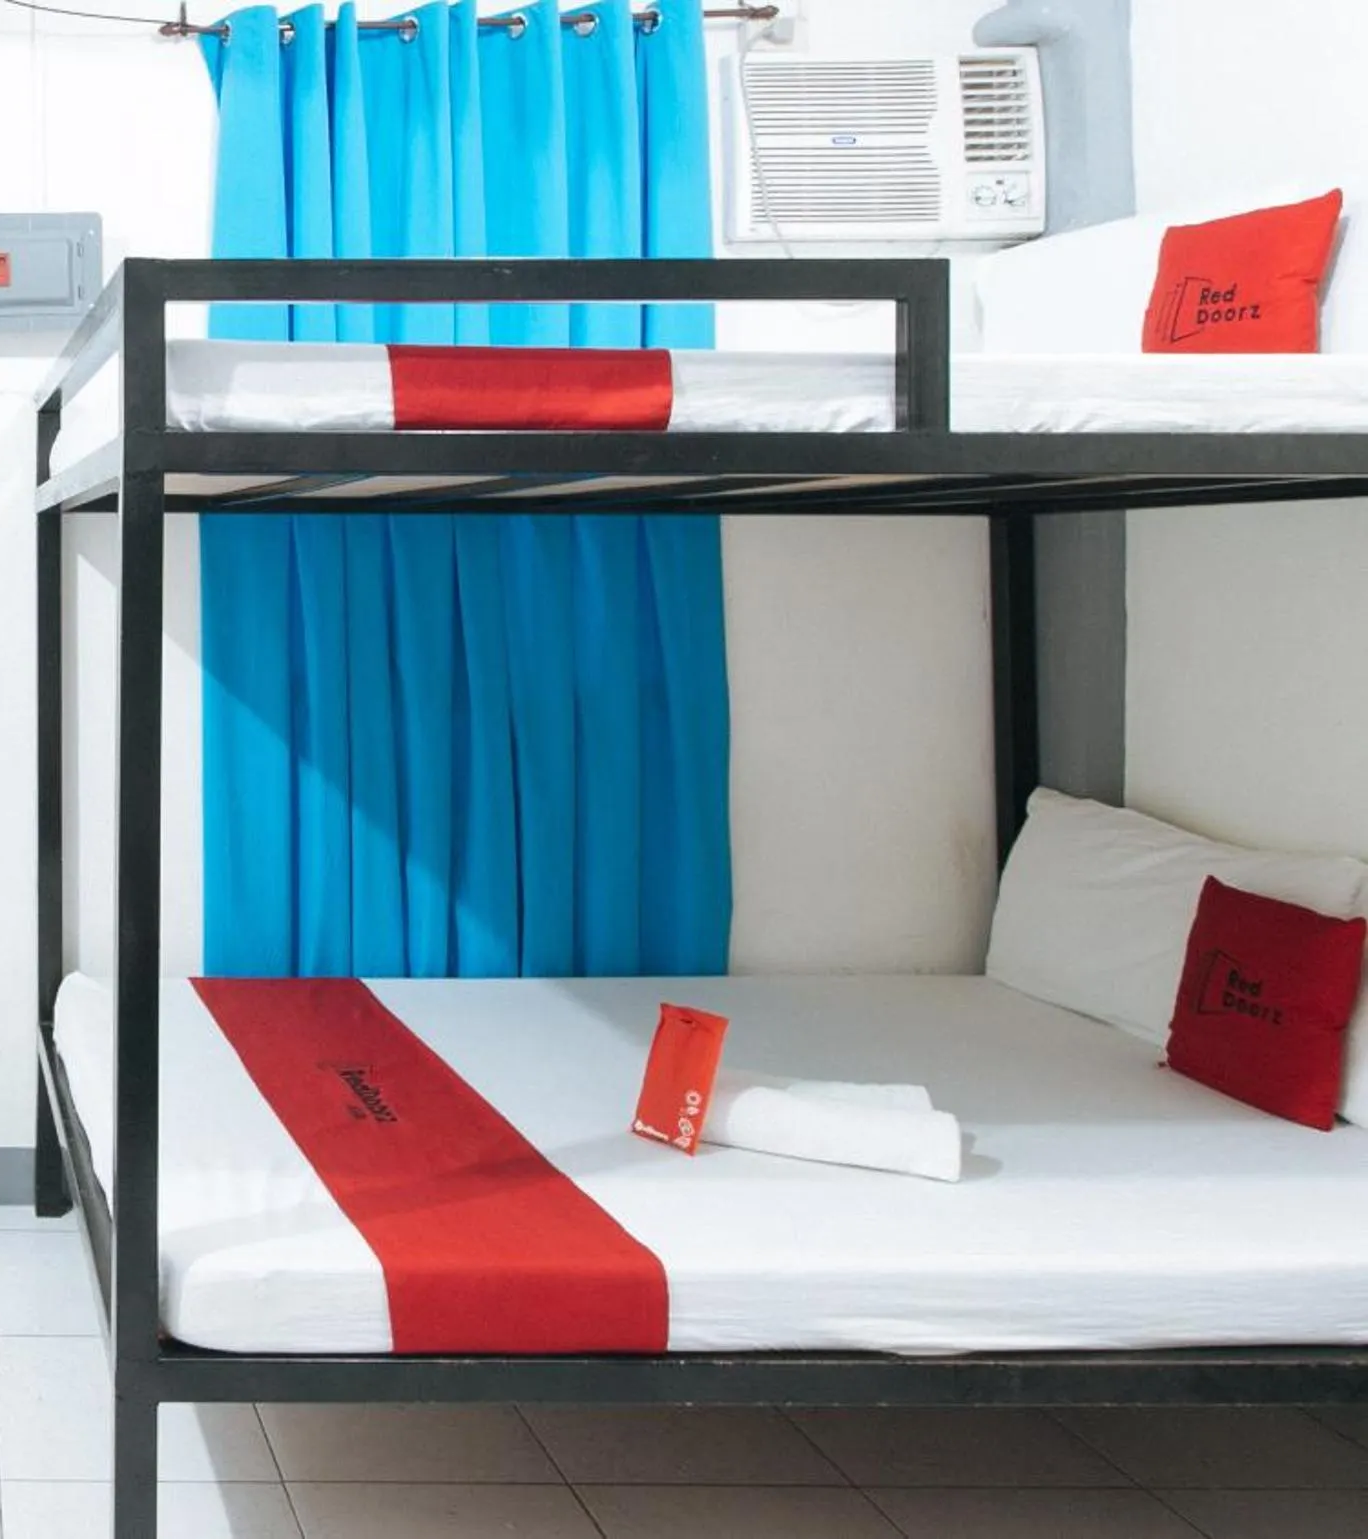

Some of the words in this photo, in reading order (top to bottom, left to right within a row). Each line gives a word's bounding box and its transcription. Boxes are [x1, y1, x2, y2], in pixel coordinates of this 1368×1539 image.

[1199, 282, 1237, 305] Red
[1196, 304, 1260, 325] Doorz
[1228, 967, 1264, 998] Red
[1222, 989, 1284, 1026] Doorz
